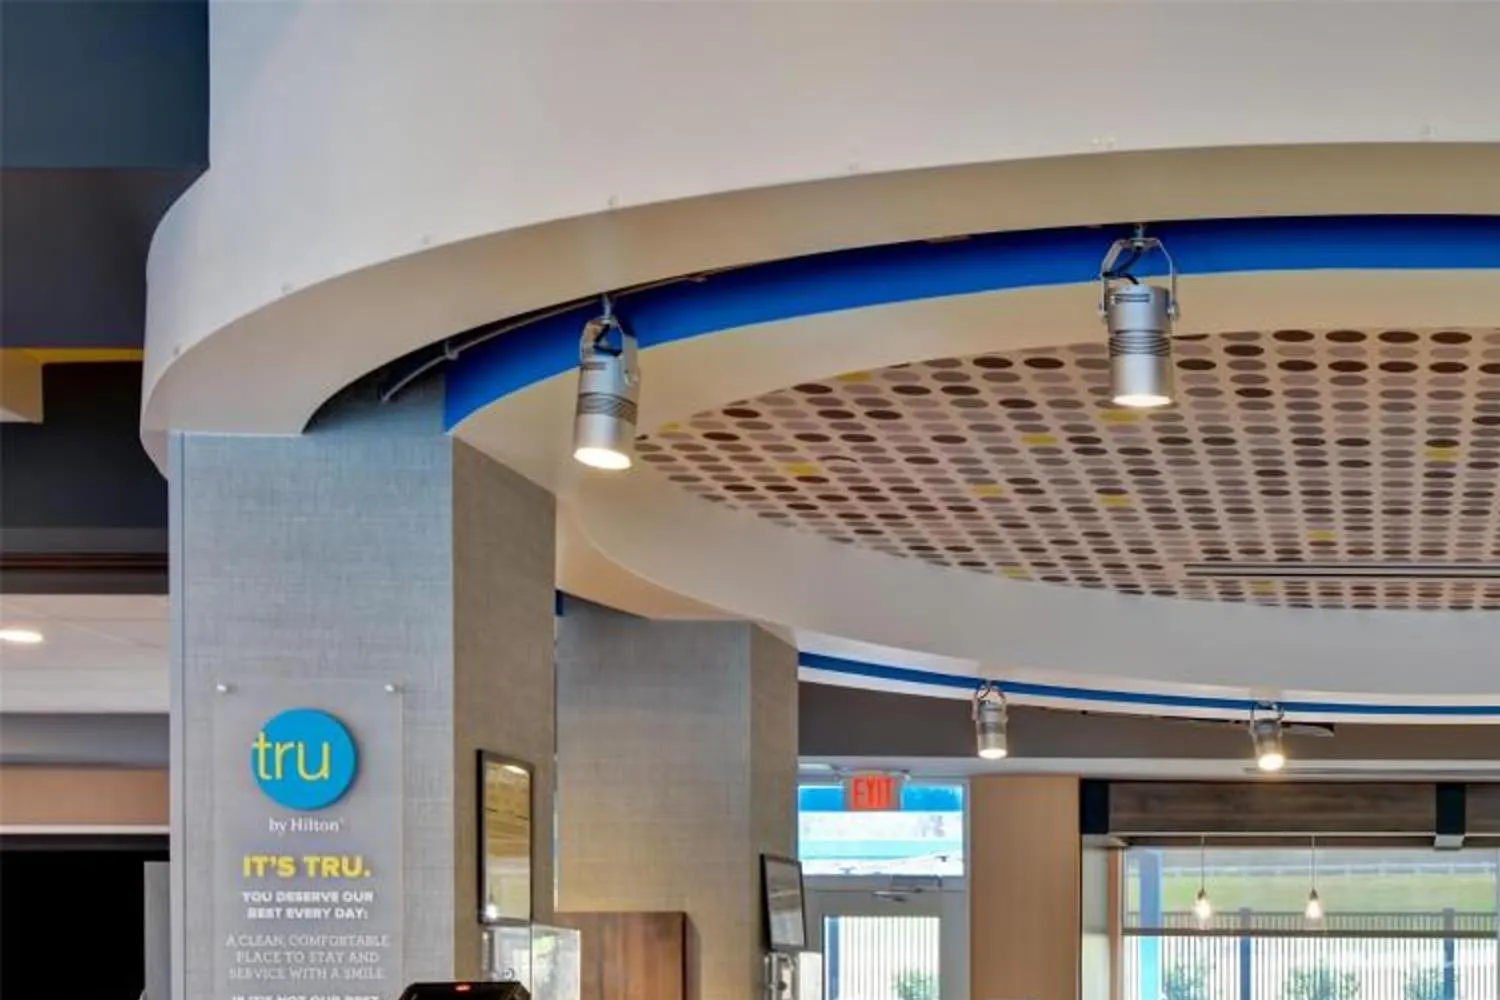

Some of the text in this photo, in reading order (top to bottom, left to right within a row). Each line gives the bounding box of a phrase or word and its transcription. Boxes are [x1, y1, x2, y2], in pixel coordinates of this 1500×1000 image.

[252, 731, 331, 781] tru
[853, 777, 893, 808] EXIT
[268, 816, 339, 838] by Hilton
[243, 855, 372, 878] IT'S TRU.
[242, 891, 374, 903] YOU DESERVE OUR
[247, 908, 368, 920] BEST EVERY DAY:
[288, 935, 391, 948] COMFORTABLE
[236, 951, 380, 964] PLACE TO STAY AND
[228, 967, 285, 980] SERVICE
[289, 967, 327, 980] WITH
[330, 967, 339, 980] A
